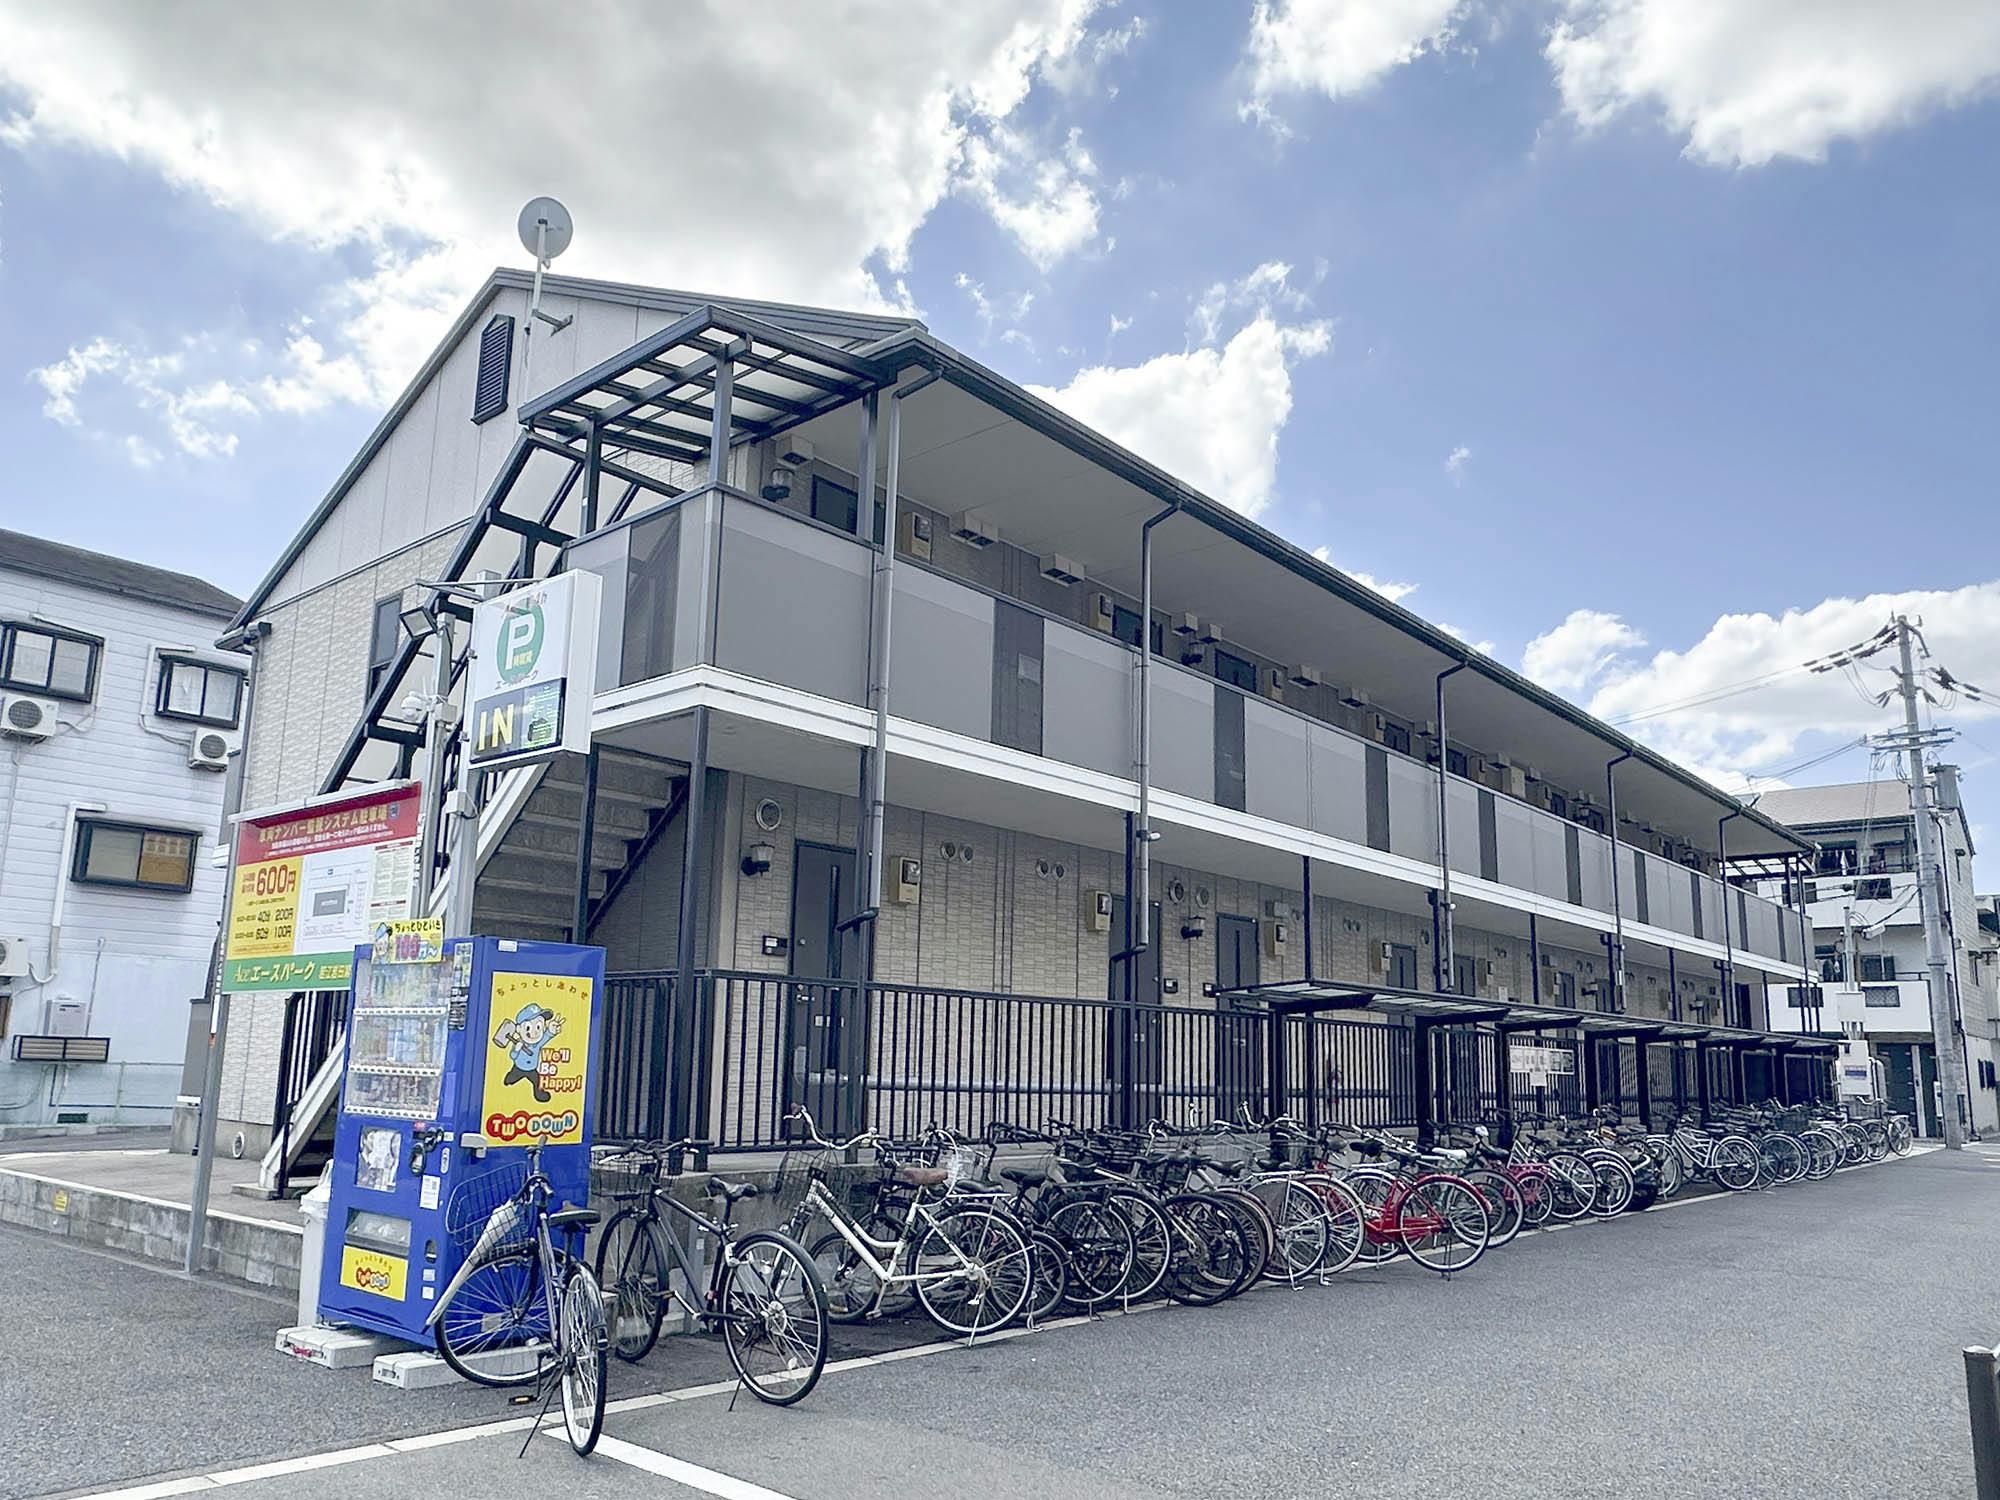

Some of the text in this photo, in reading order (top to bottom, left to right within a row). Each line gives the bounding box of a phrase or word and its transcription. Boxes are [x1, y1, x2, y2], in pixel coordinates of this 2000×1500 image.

[504, 613, 536, 671] P
[477, 703, 515, 752] IN
[256, 864, 297, 896] 600円
[275, 907, 294, 921] 200円
[274, 925, 292, 938] 100円
[250, 960, 316, 983] エースパーク
[496, 978, 589, 1001] ちょっとしあわせ
[540, 1048, 571, 1063] We'll
[539, 1062, 557, 1076] Be
[539, 1075, 583, 1093] Happy!
